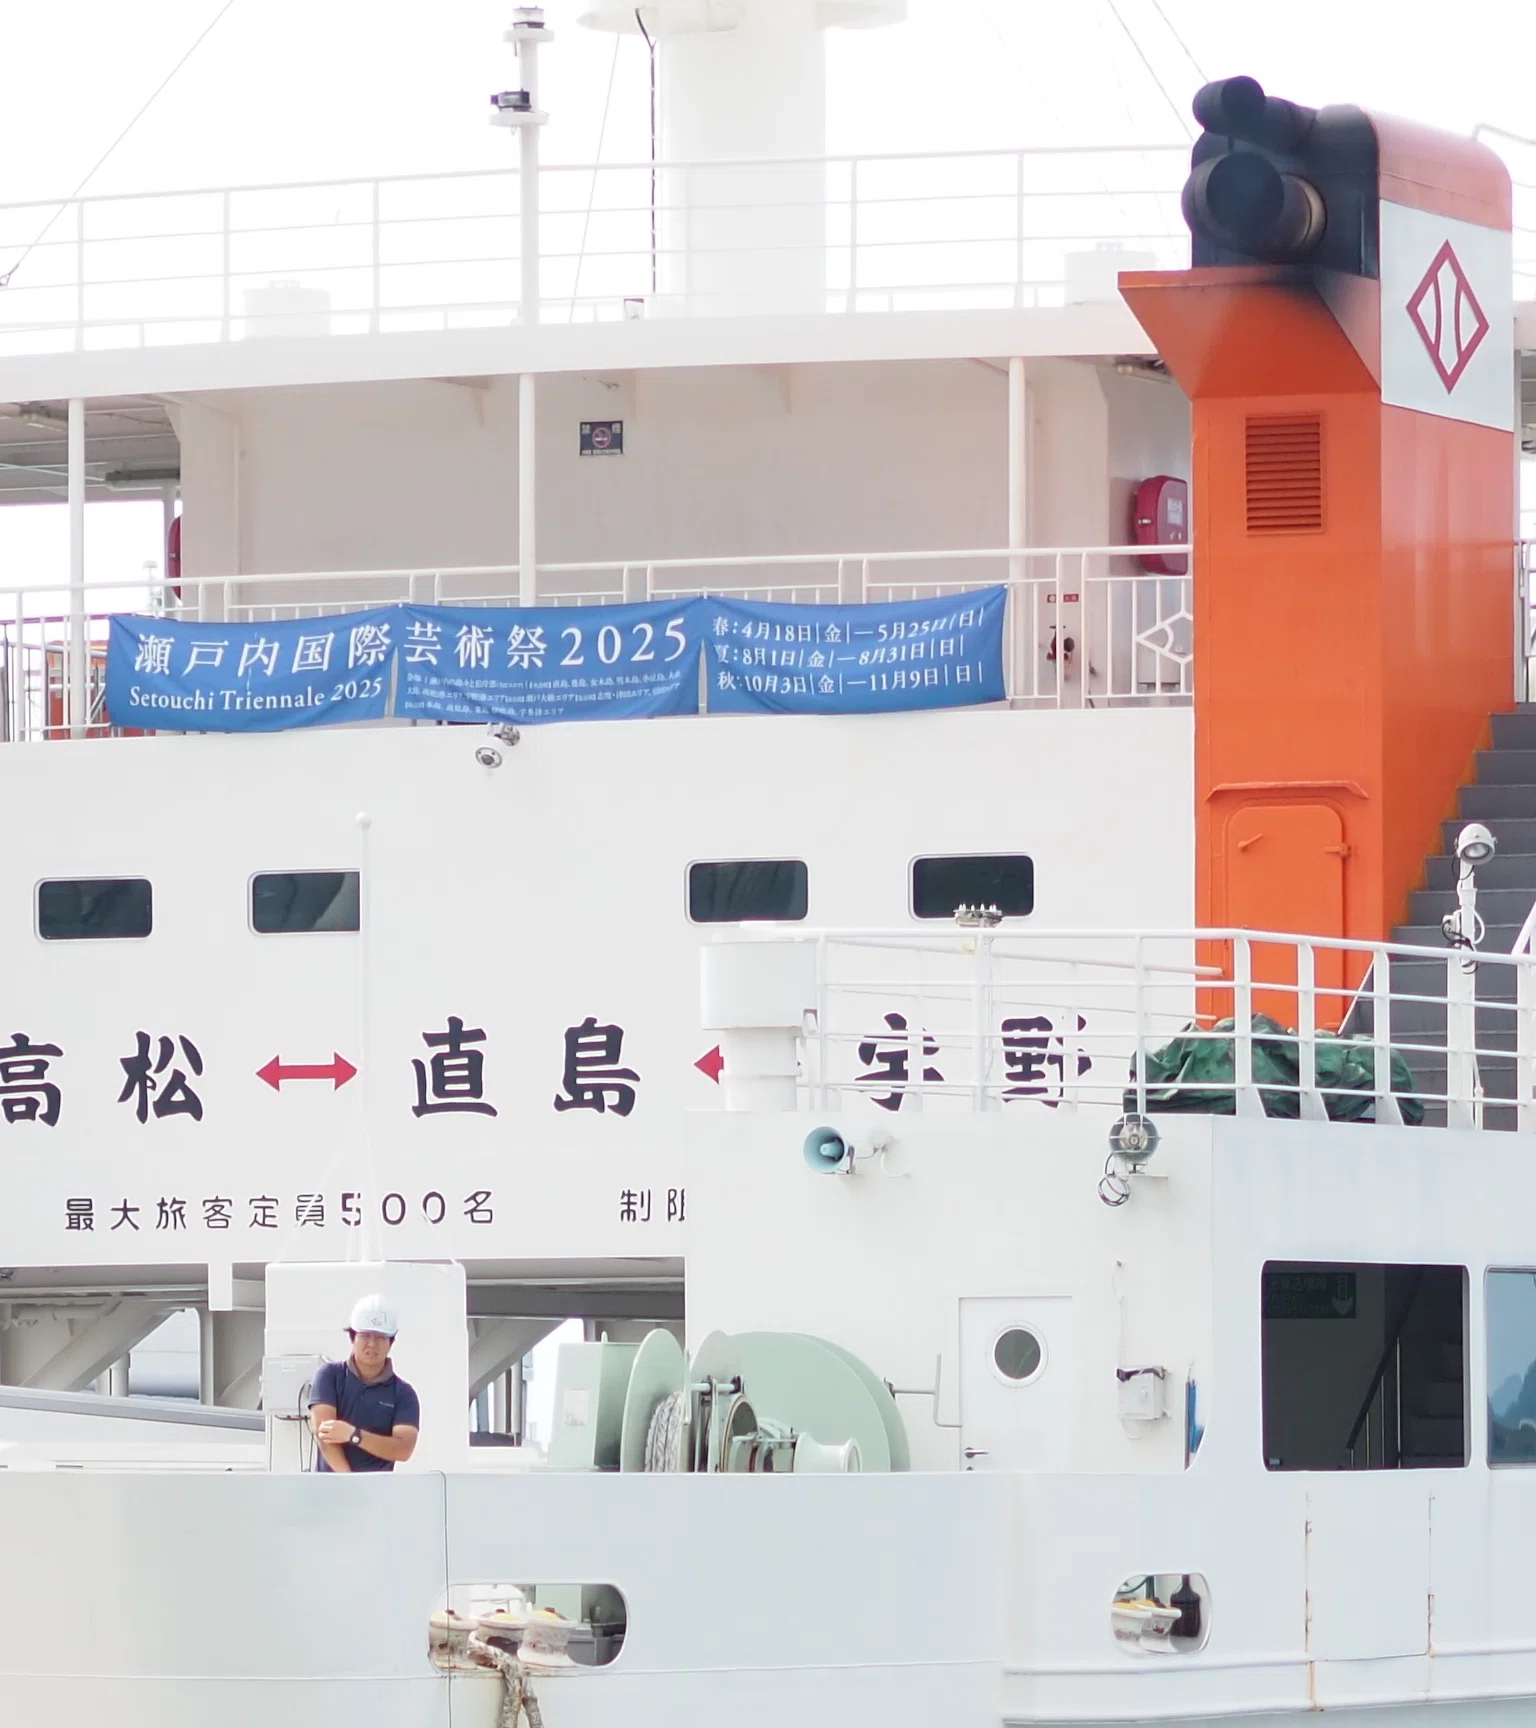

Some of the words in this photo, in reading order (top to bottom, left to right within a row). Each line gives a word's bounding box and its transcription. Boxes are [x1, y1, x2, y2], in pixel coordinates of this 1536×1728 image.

[129, 686, 214, 710] Setouchi
[220, 685, 325, 710] Triennale
[330, 677, 383, 702] 2025
[410, 1015, 642, 1119] 直島
